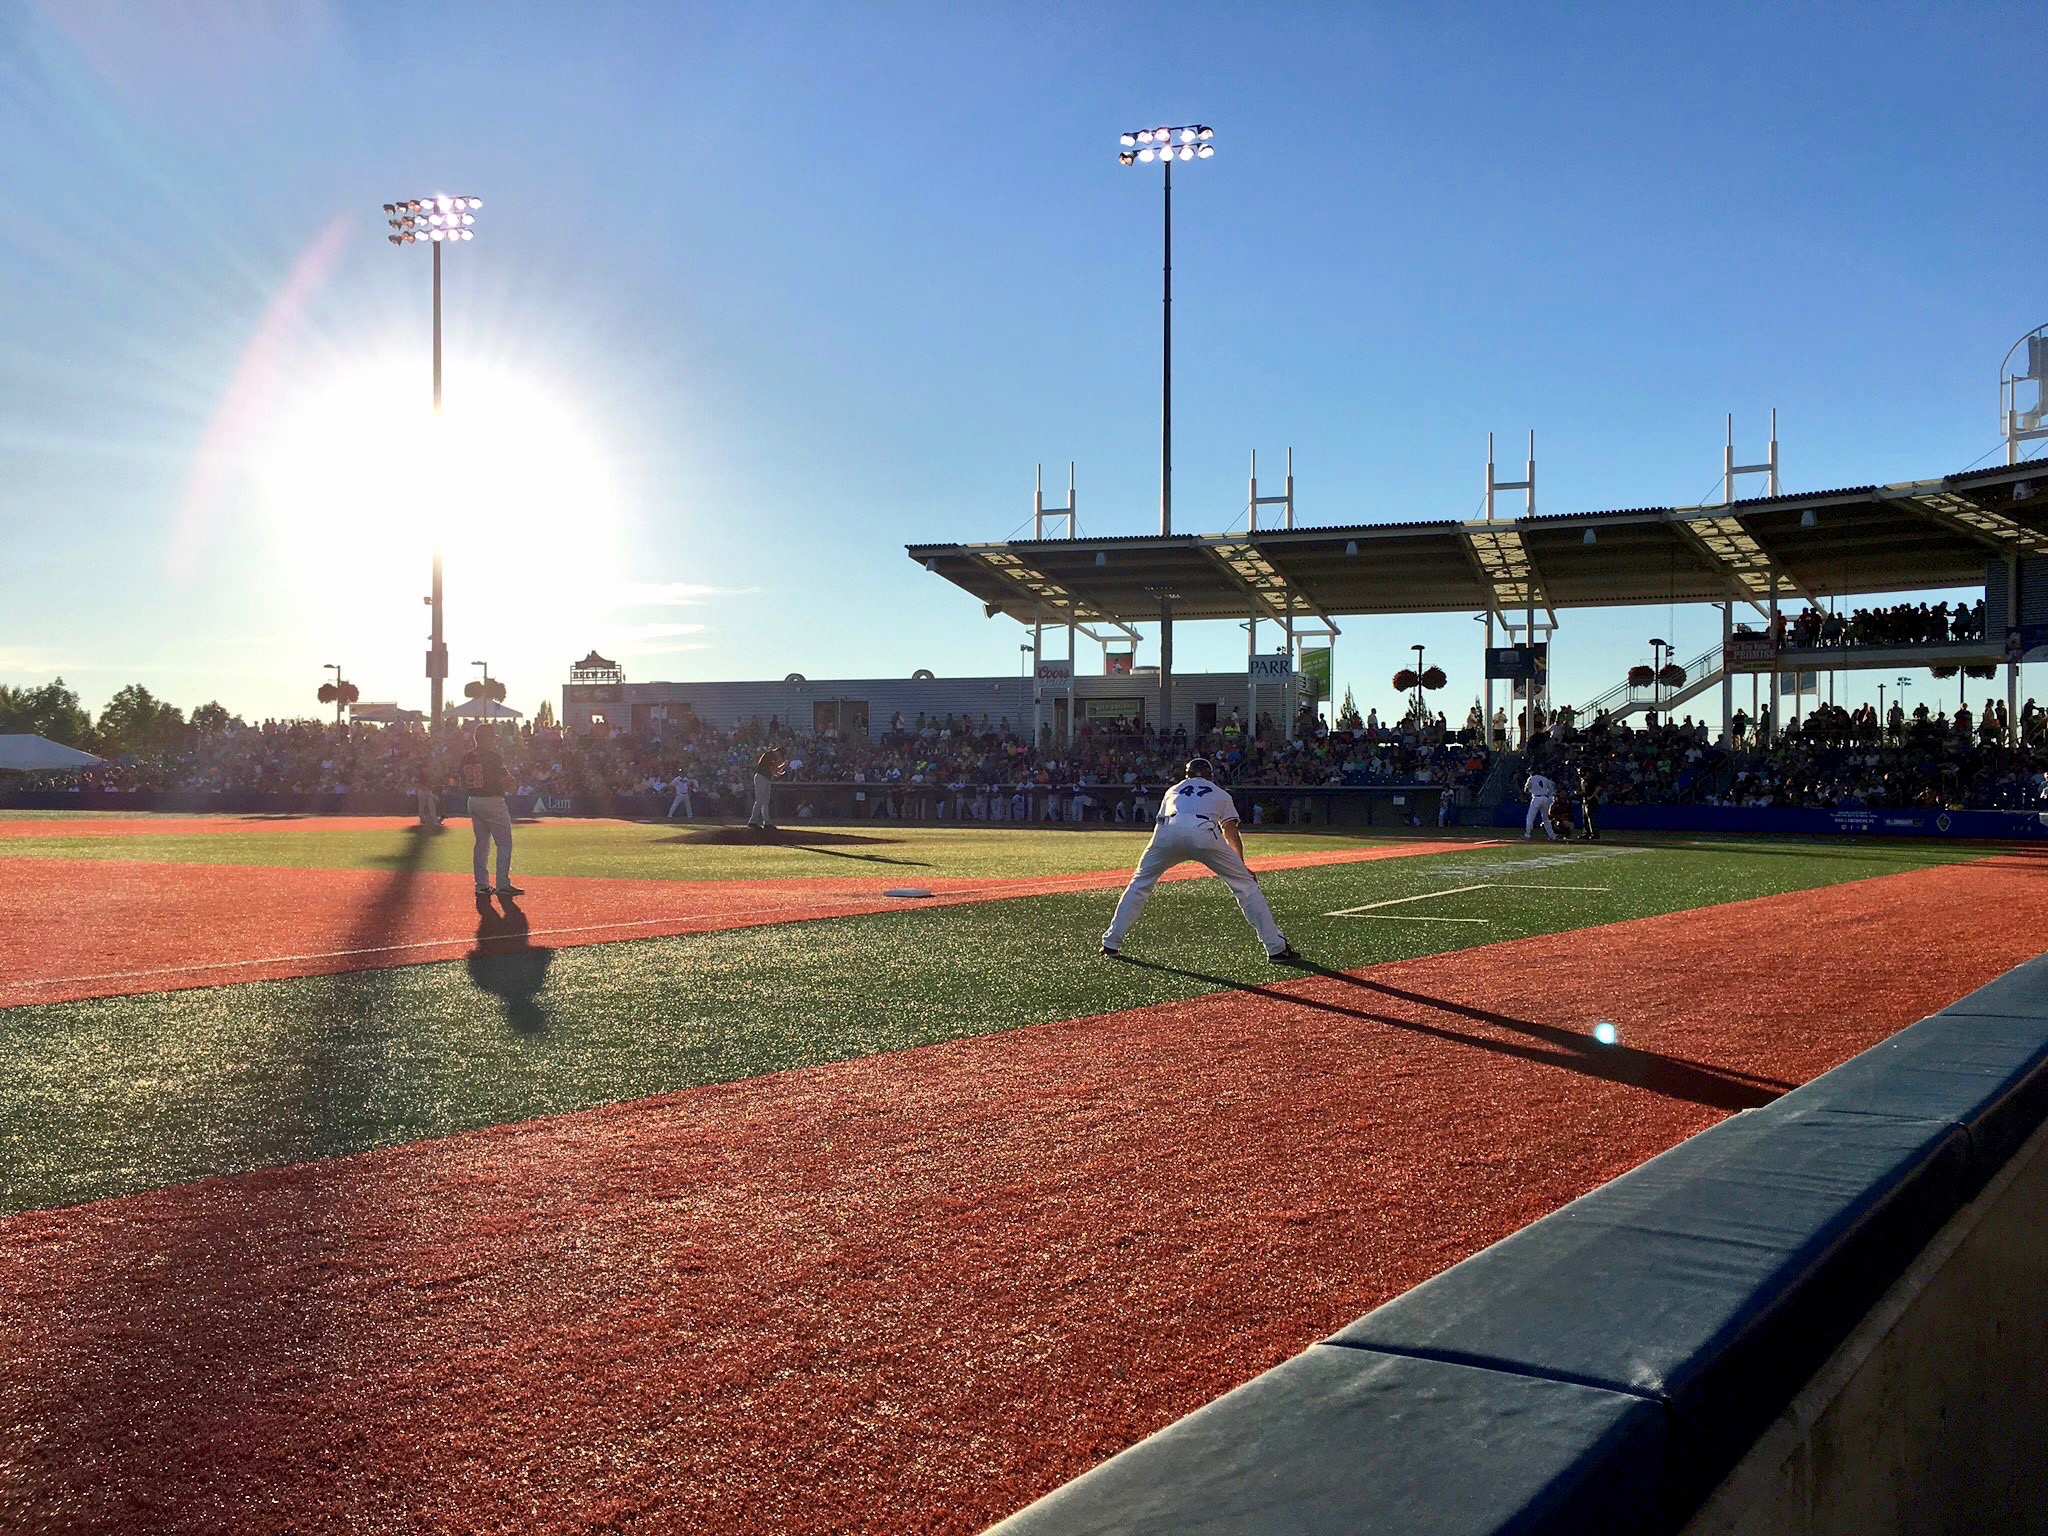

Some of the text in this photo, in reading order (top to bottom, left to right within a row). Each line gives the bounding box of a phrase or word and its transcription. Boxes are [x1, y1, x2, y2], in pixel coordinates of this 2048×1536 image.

[1734, 649, 1776, 660] PROMISE
[1038, 666, 1070, 679] Coors
[1251, 660, 1290, 674] PARR
[573, 670, 618, 679] BREW PEN
[1179, 785, 1213, 797] 47
[548, 796, 571, 809] Lam
